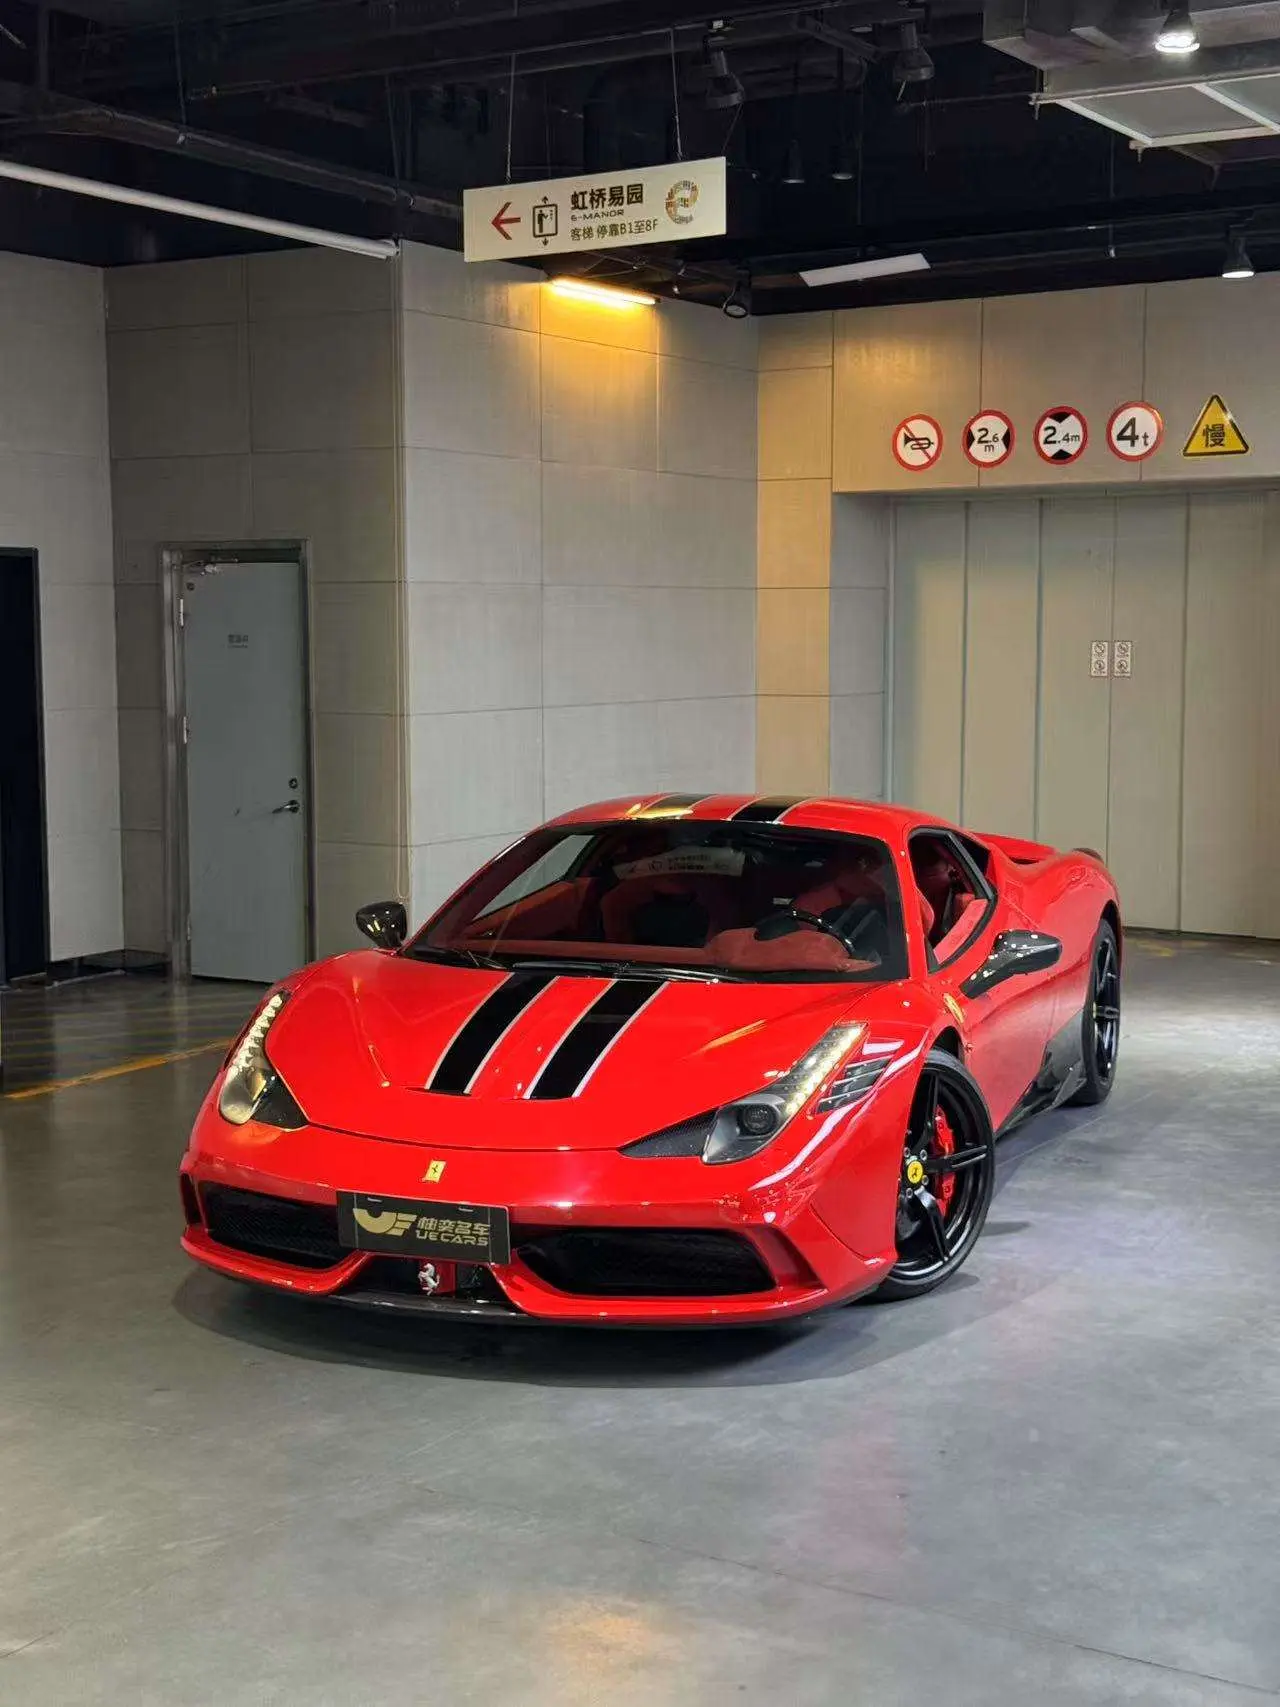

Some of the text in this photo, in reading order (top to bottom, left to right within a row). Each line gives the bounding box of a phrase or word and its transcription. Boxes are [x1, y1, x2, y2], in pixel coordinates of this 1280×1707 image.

[570, 183, 644, 211] 虹桥易园
[977, 427, 999, 444] 2.6
[1043, 426, 1080, 444] 2.4m
[1203, 423, 1225, 447] 慢
[984, 443, 995, 453] m
